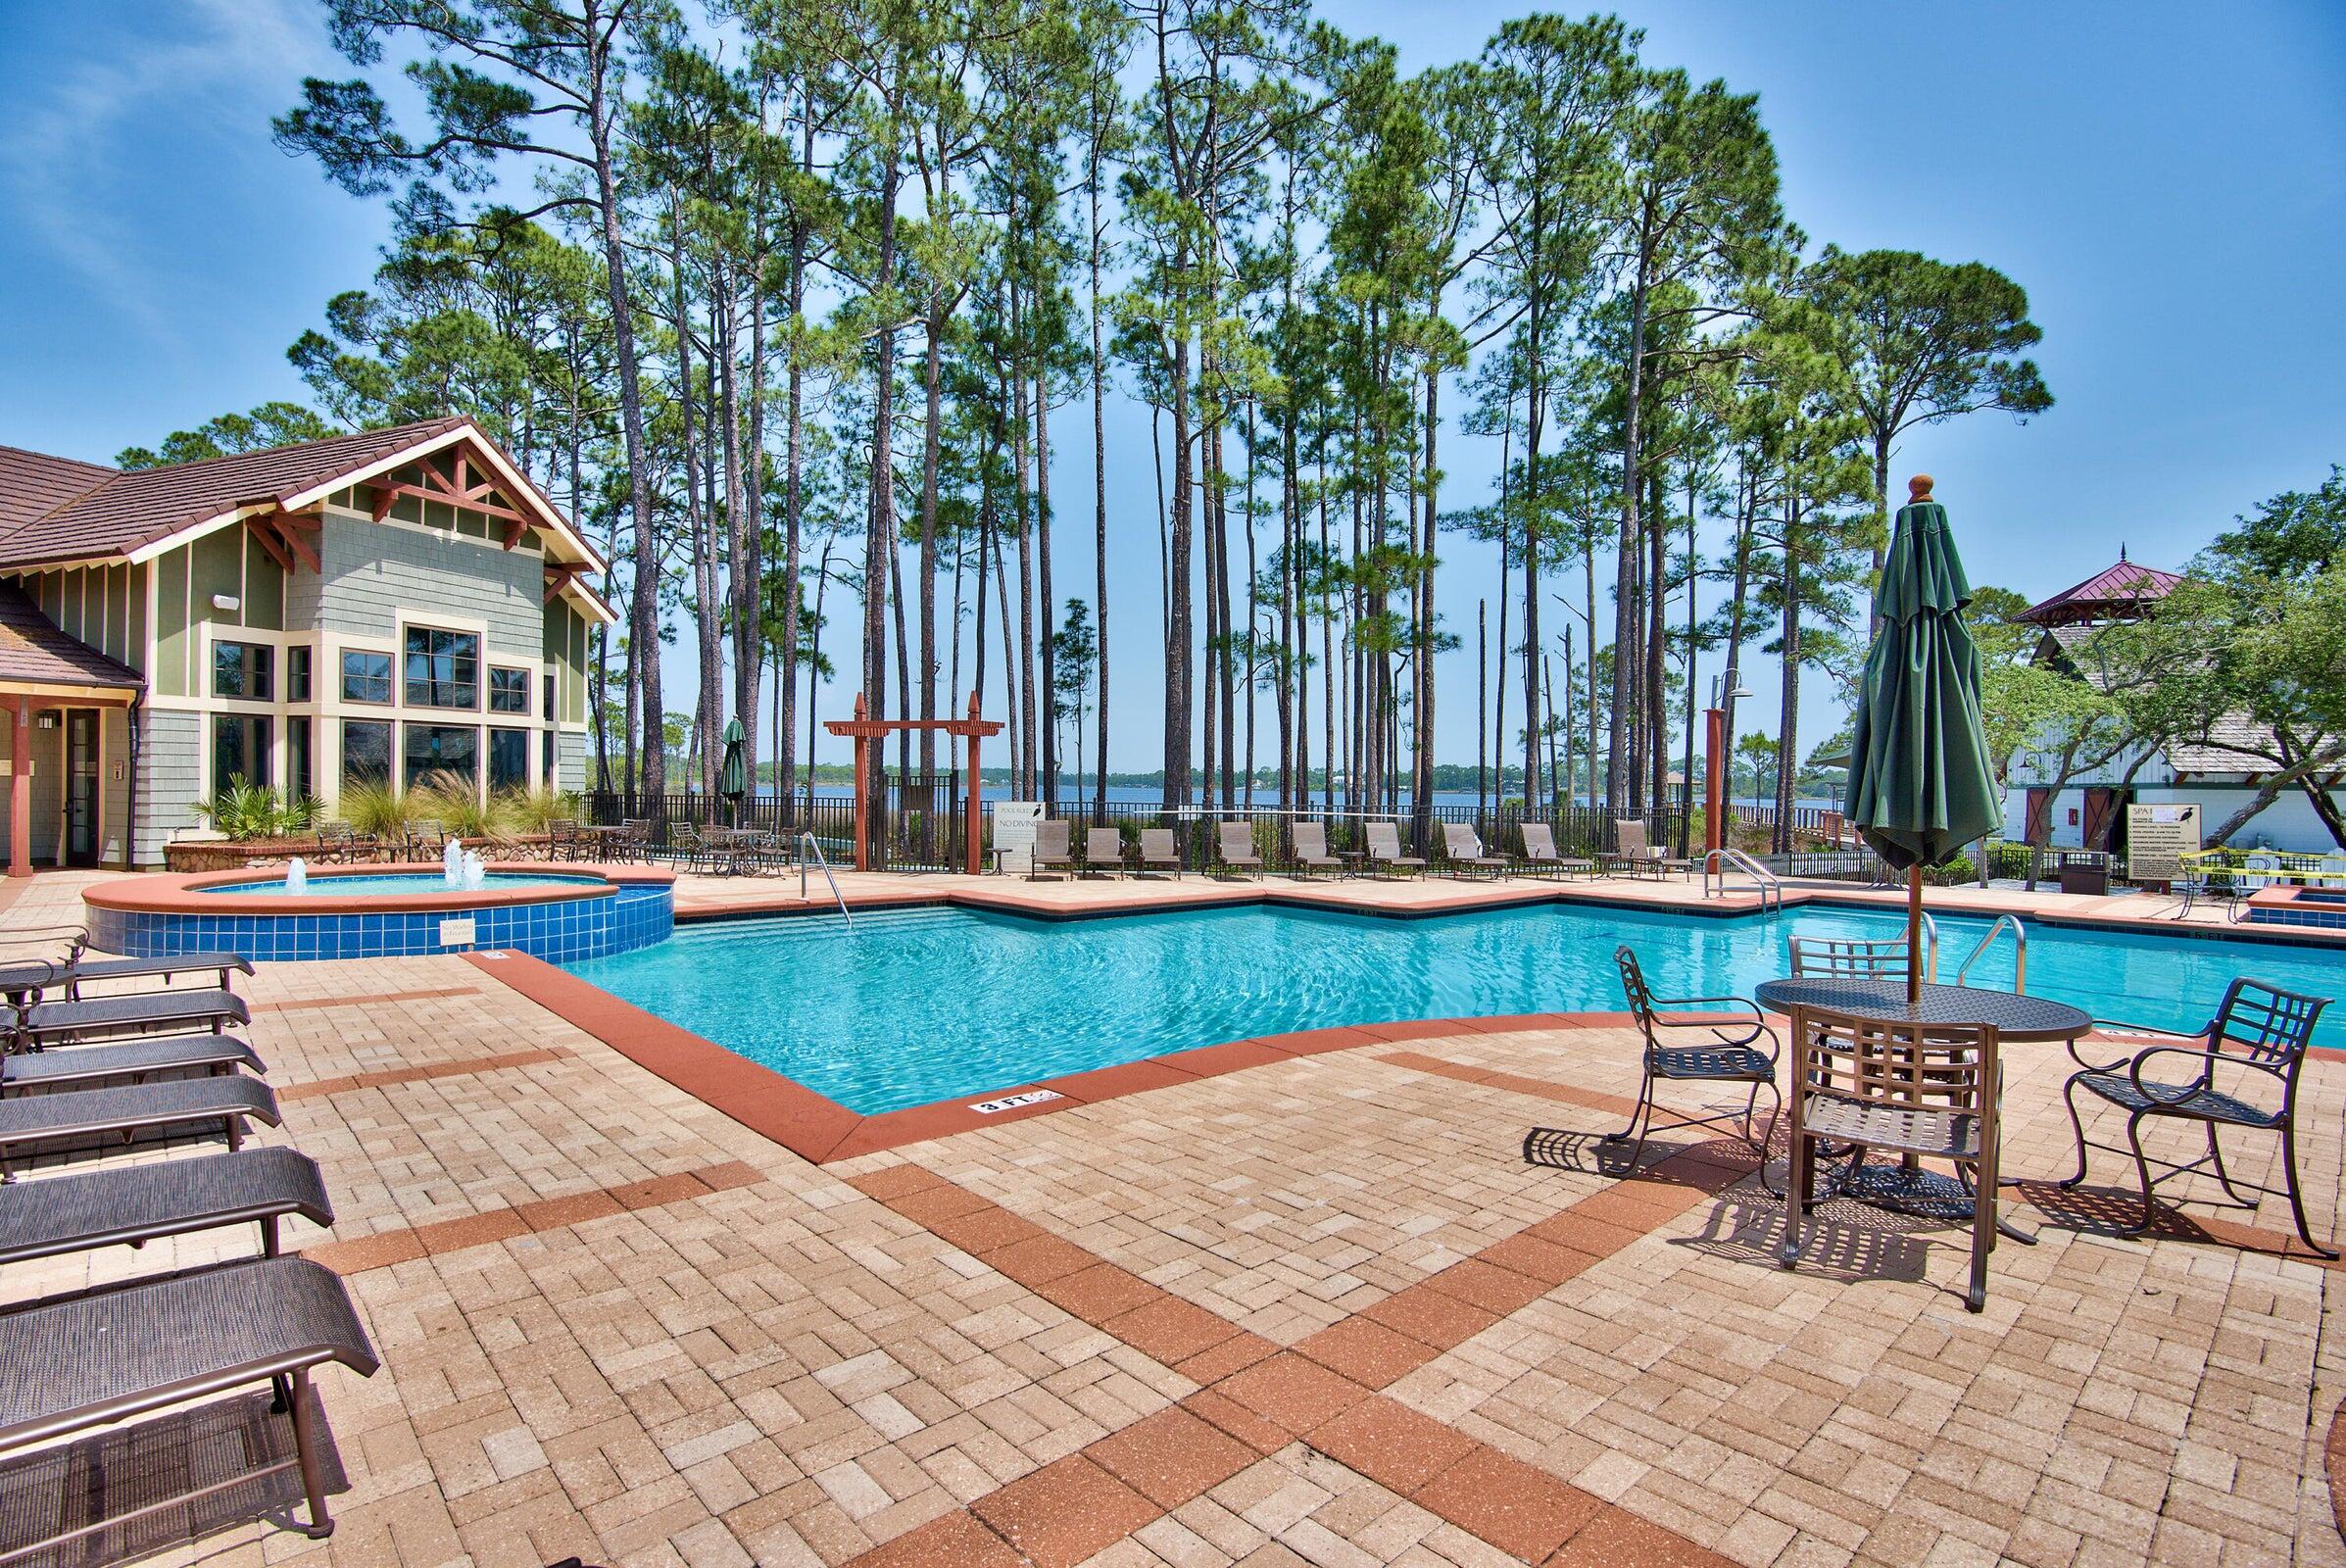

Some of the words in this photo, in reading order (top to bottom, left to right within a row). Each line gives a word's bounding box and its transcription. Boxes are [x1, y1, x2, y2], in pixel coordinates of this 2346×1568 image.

[2195, 931, 2202, 940] 5
[2207, 932, 2223, 941] FT
[1002, 1096, 1029, 1106] FT
